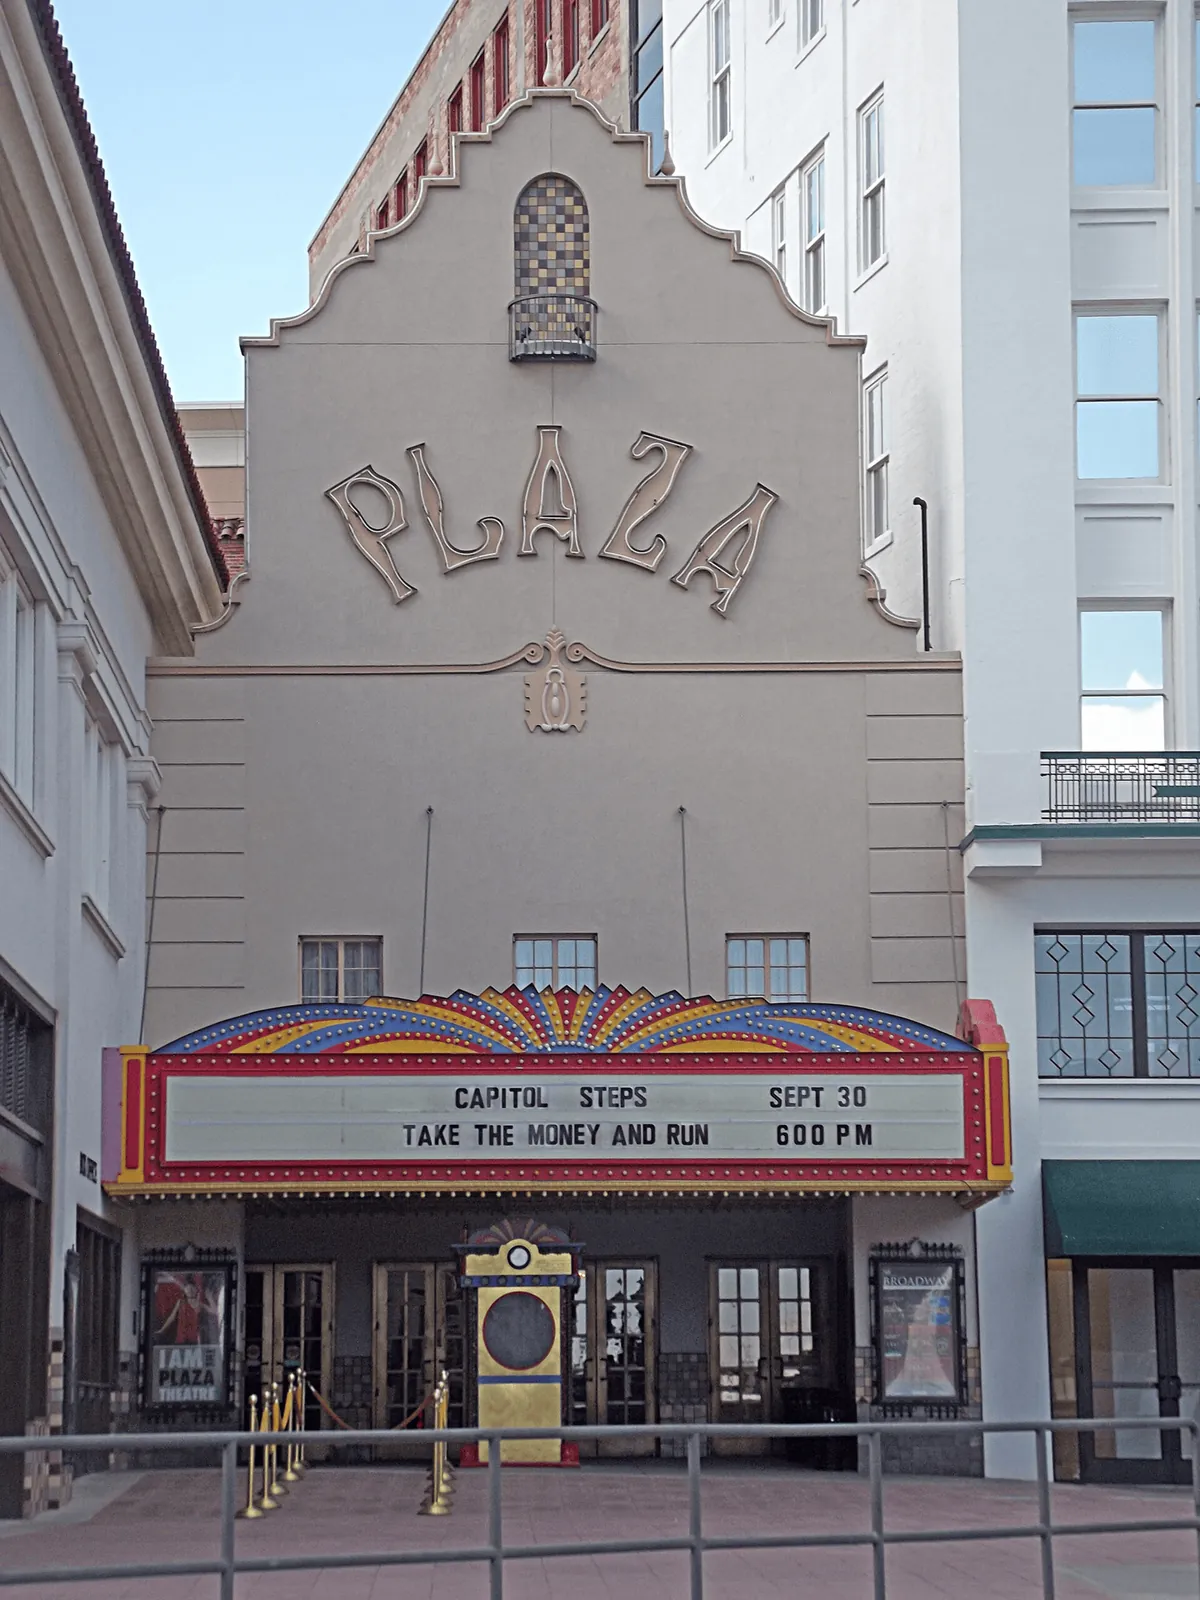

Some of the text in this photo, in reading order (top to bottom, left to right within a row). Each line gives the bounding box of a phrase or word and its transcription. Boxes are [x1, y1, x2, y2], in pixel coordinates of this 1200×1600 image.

[324, 424, 780, 618] PLAZA
[455, 1086, 647, 1109] CAPITOL STEPS
[769, 1086, 867, 1109] SEPT 30
[403, 1123, 709, 1147] TAKE THE MONEY AND RUN
[776, 1123, 873, 1146] 600 PM
[883, 1275, 949, 1288] BROADWAY
[159, 1349, 166, 1369] I
[169, 1349, 203, 1369] AM
[159, 1369, 215, 1386] PLAZA
[159, 1386, 216, 1401] THEATRE
